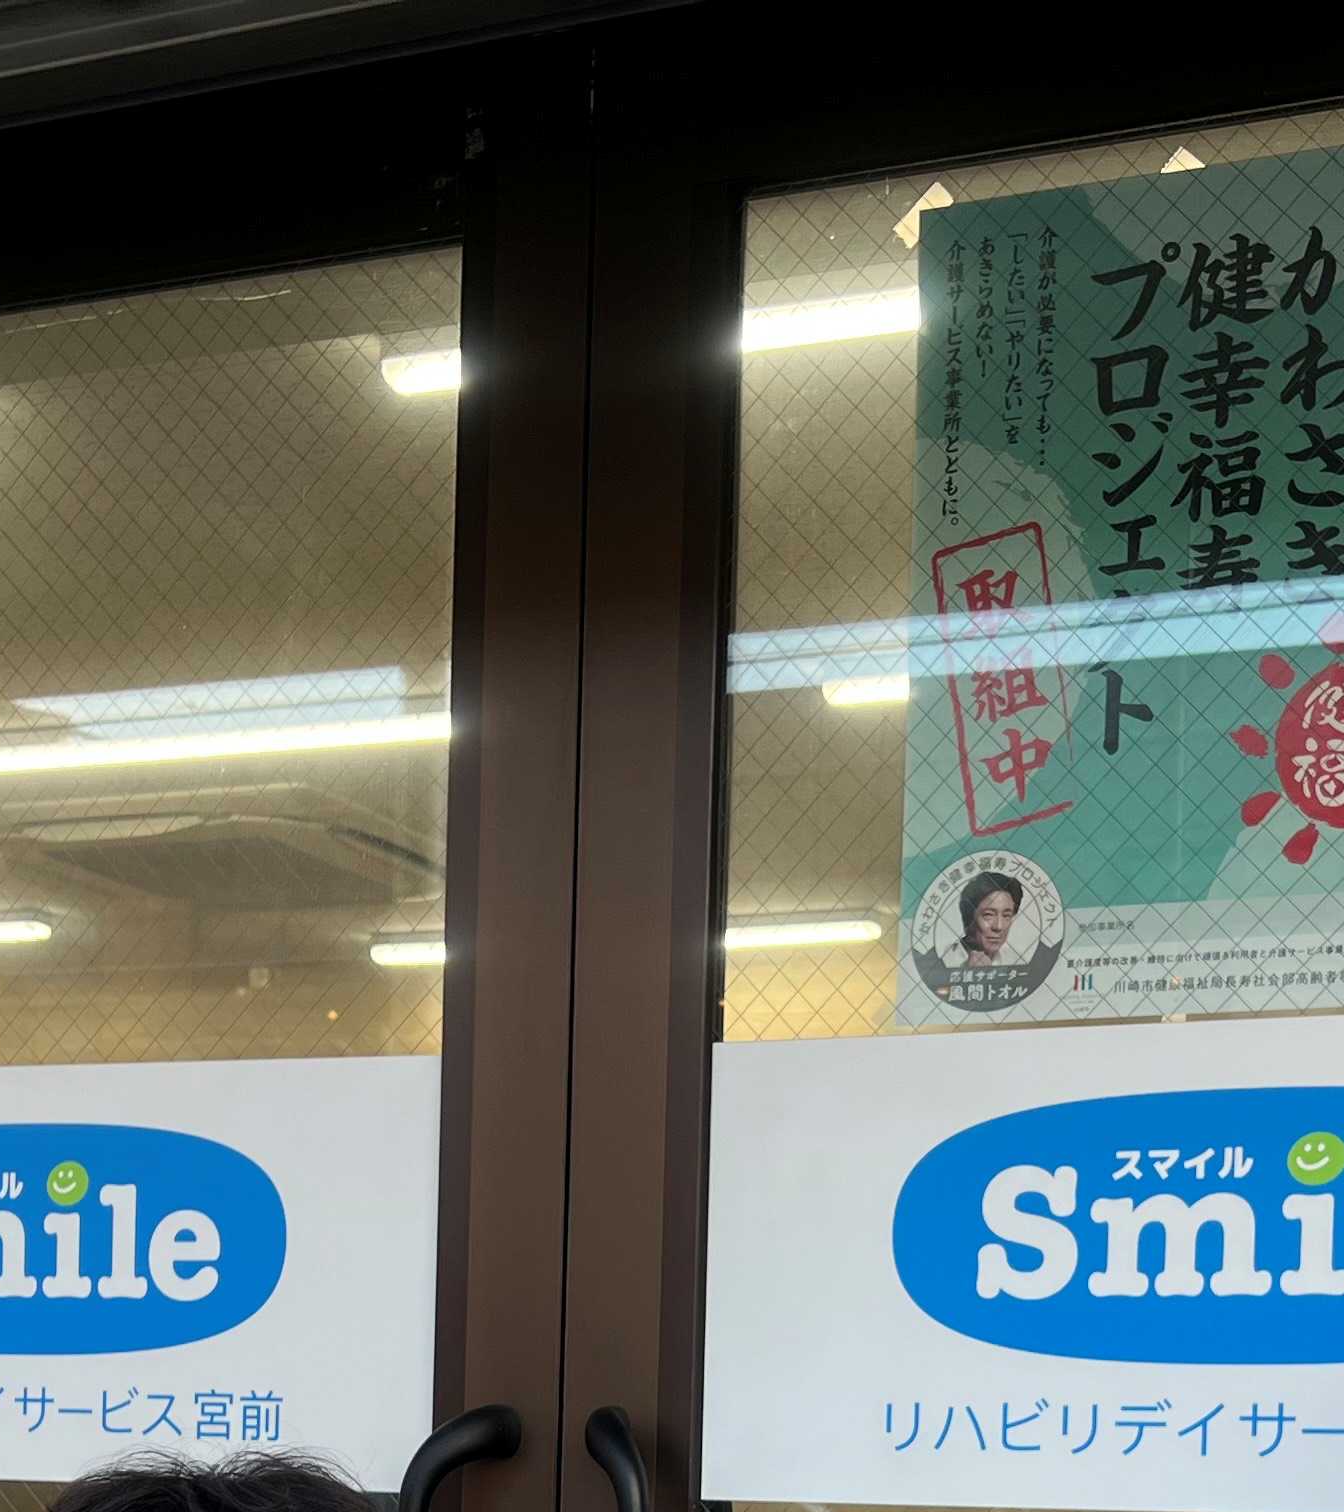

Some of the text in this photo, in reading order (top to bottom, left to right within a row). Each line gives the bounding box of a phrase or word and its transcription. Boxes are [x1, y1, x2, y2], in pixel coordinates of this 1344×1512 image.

[1169, 232, 1276, 613] 健幸福寿
[949, 969, 1029, 984] 応援サポーター
[949, 983, 1029, 1002] 風間トオル
[1113, 1145, 1255, 1182] スマイル
